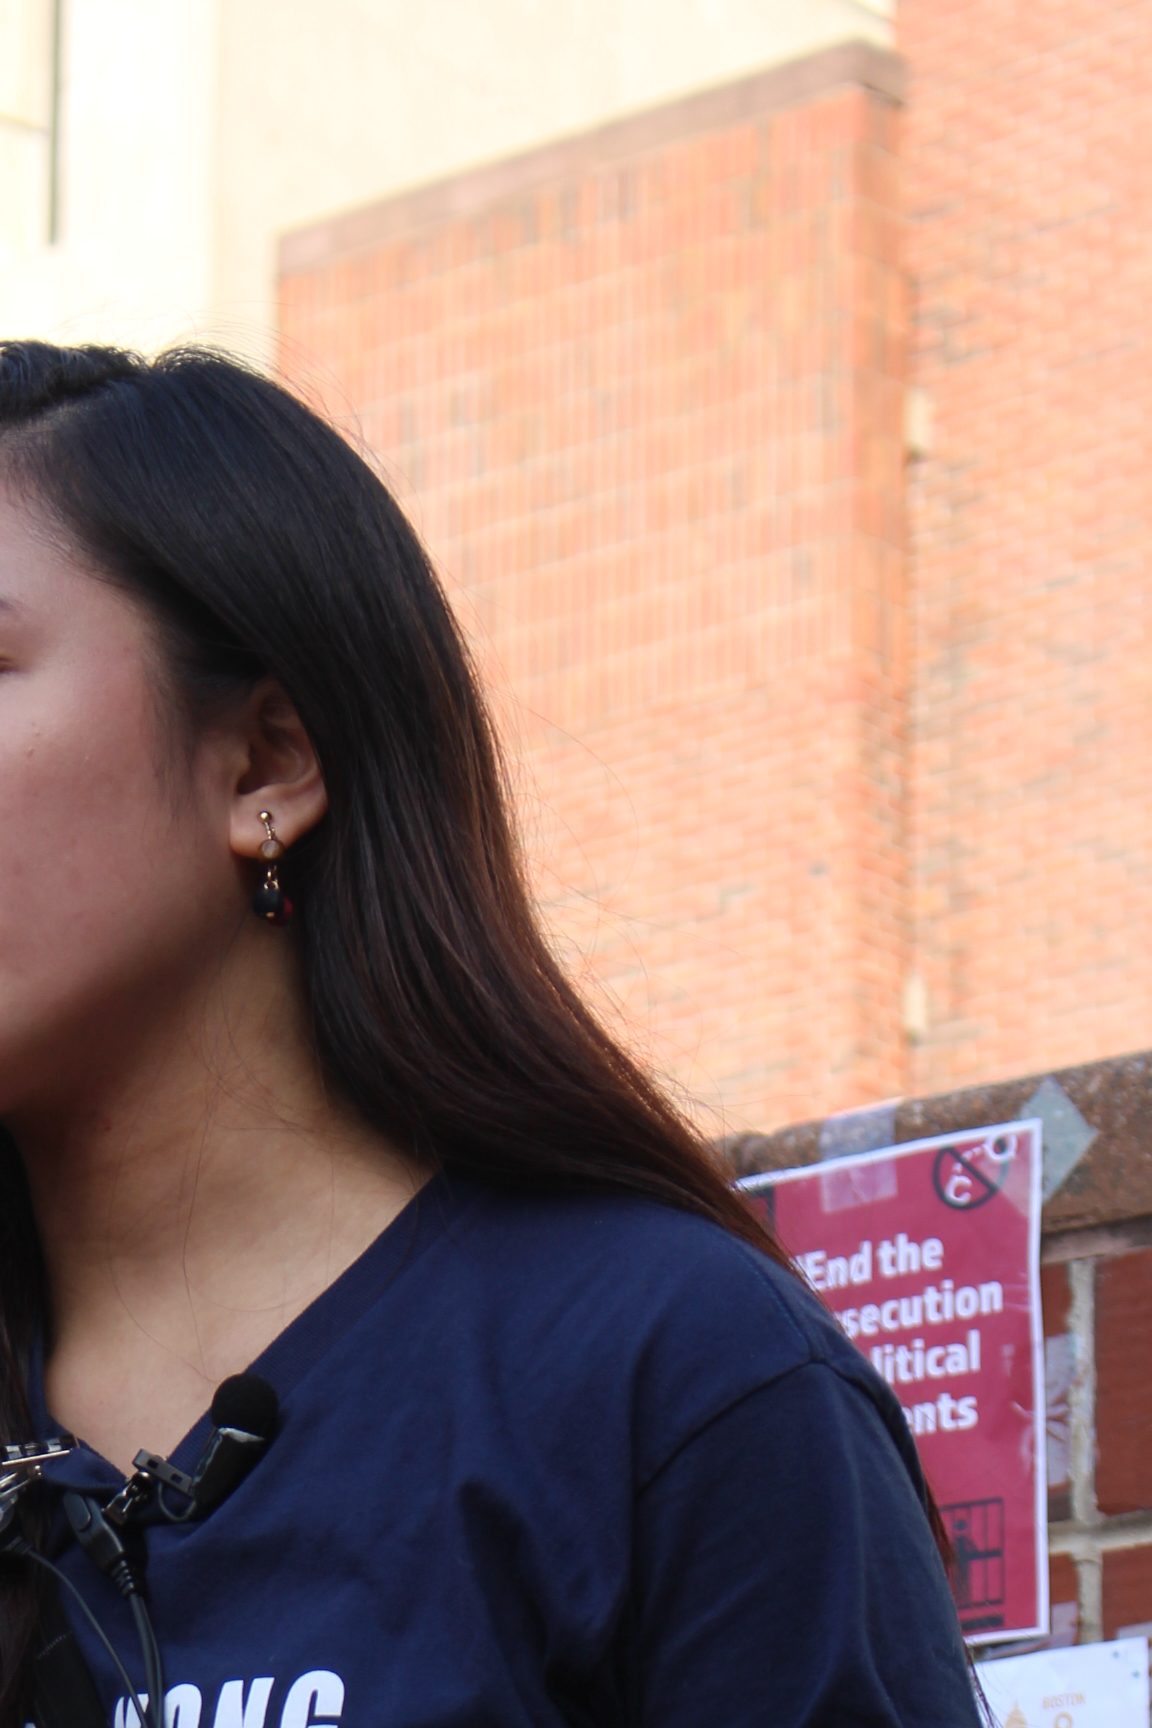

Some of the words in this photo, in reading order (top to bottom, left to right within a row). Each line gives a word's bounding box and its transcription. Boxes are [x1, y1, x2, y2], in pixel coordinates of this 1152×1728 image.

[878, 1233, 944, 1276] the
[837, 1280, 1003, 1341] secution
[870, 1329, 981, 1384] litical
